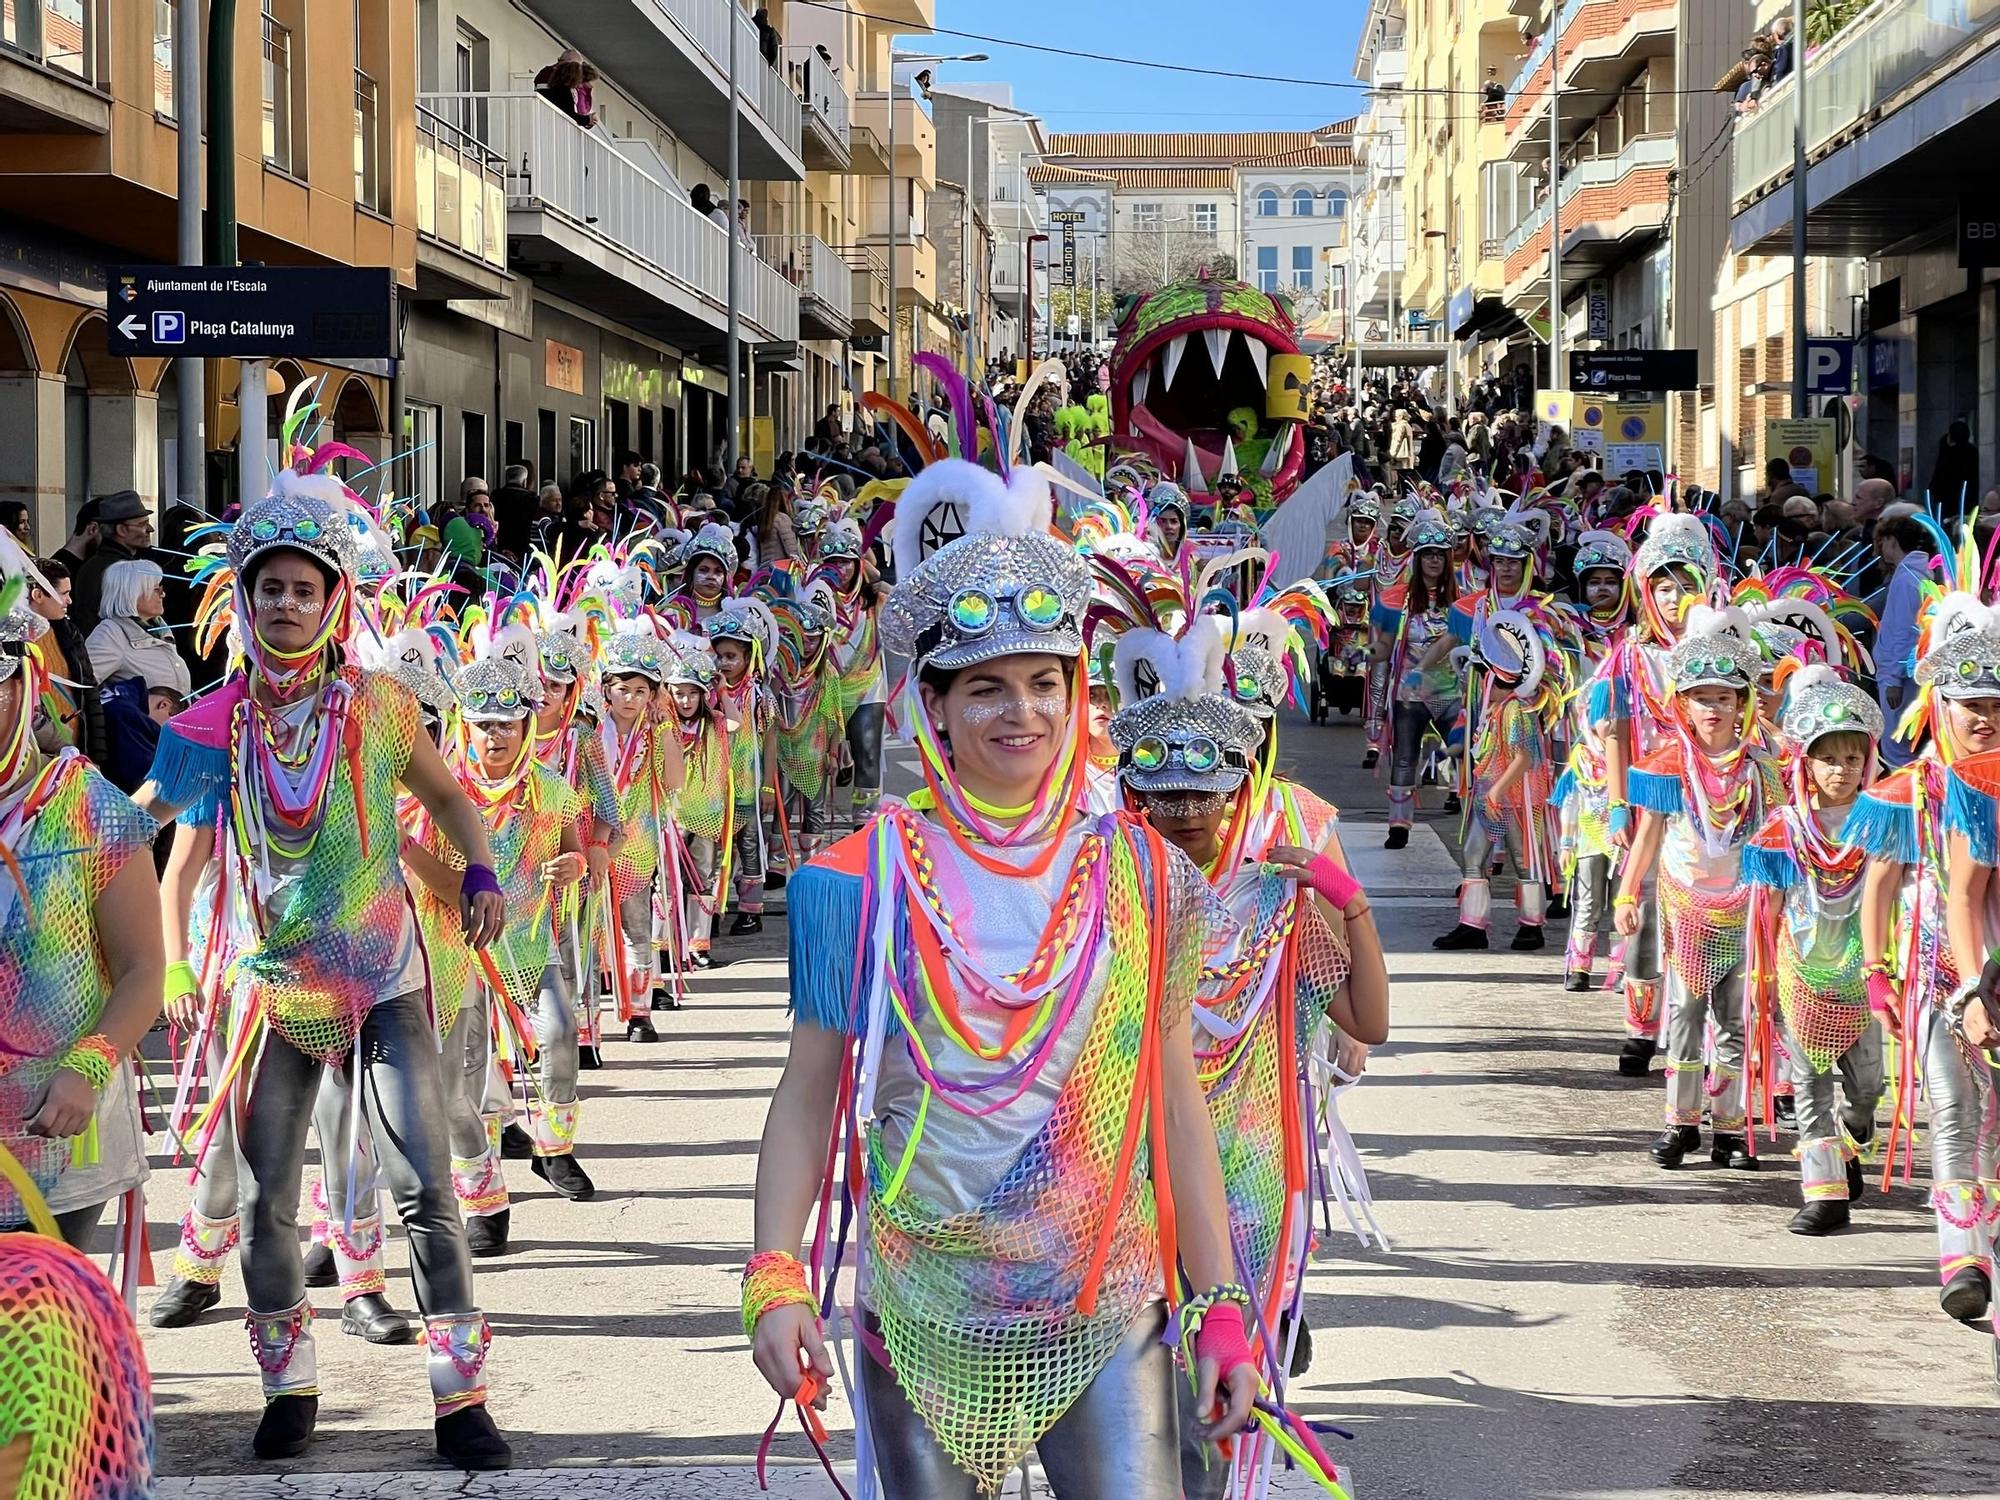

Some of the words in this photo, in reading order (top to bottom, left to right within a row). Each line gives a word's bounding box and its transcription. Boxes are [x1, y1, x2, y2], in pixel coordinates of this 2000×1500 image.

[1053, 213, 1084, 221] HOTEL
[1966, 222, 2000, 239] BB
[147, 280, 207, 292] Ajuntament
[210, 281, 223, 292] de
[226, 281, 267, 292] l'Escala
[158, 315, 178, 339] P
[190, 320, 226, 338] Plaça
[230, 321, 295, 338] Catalunya
[1807, 347, 1841, 389] P
